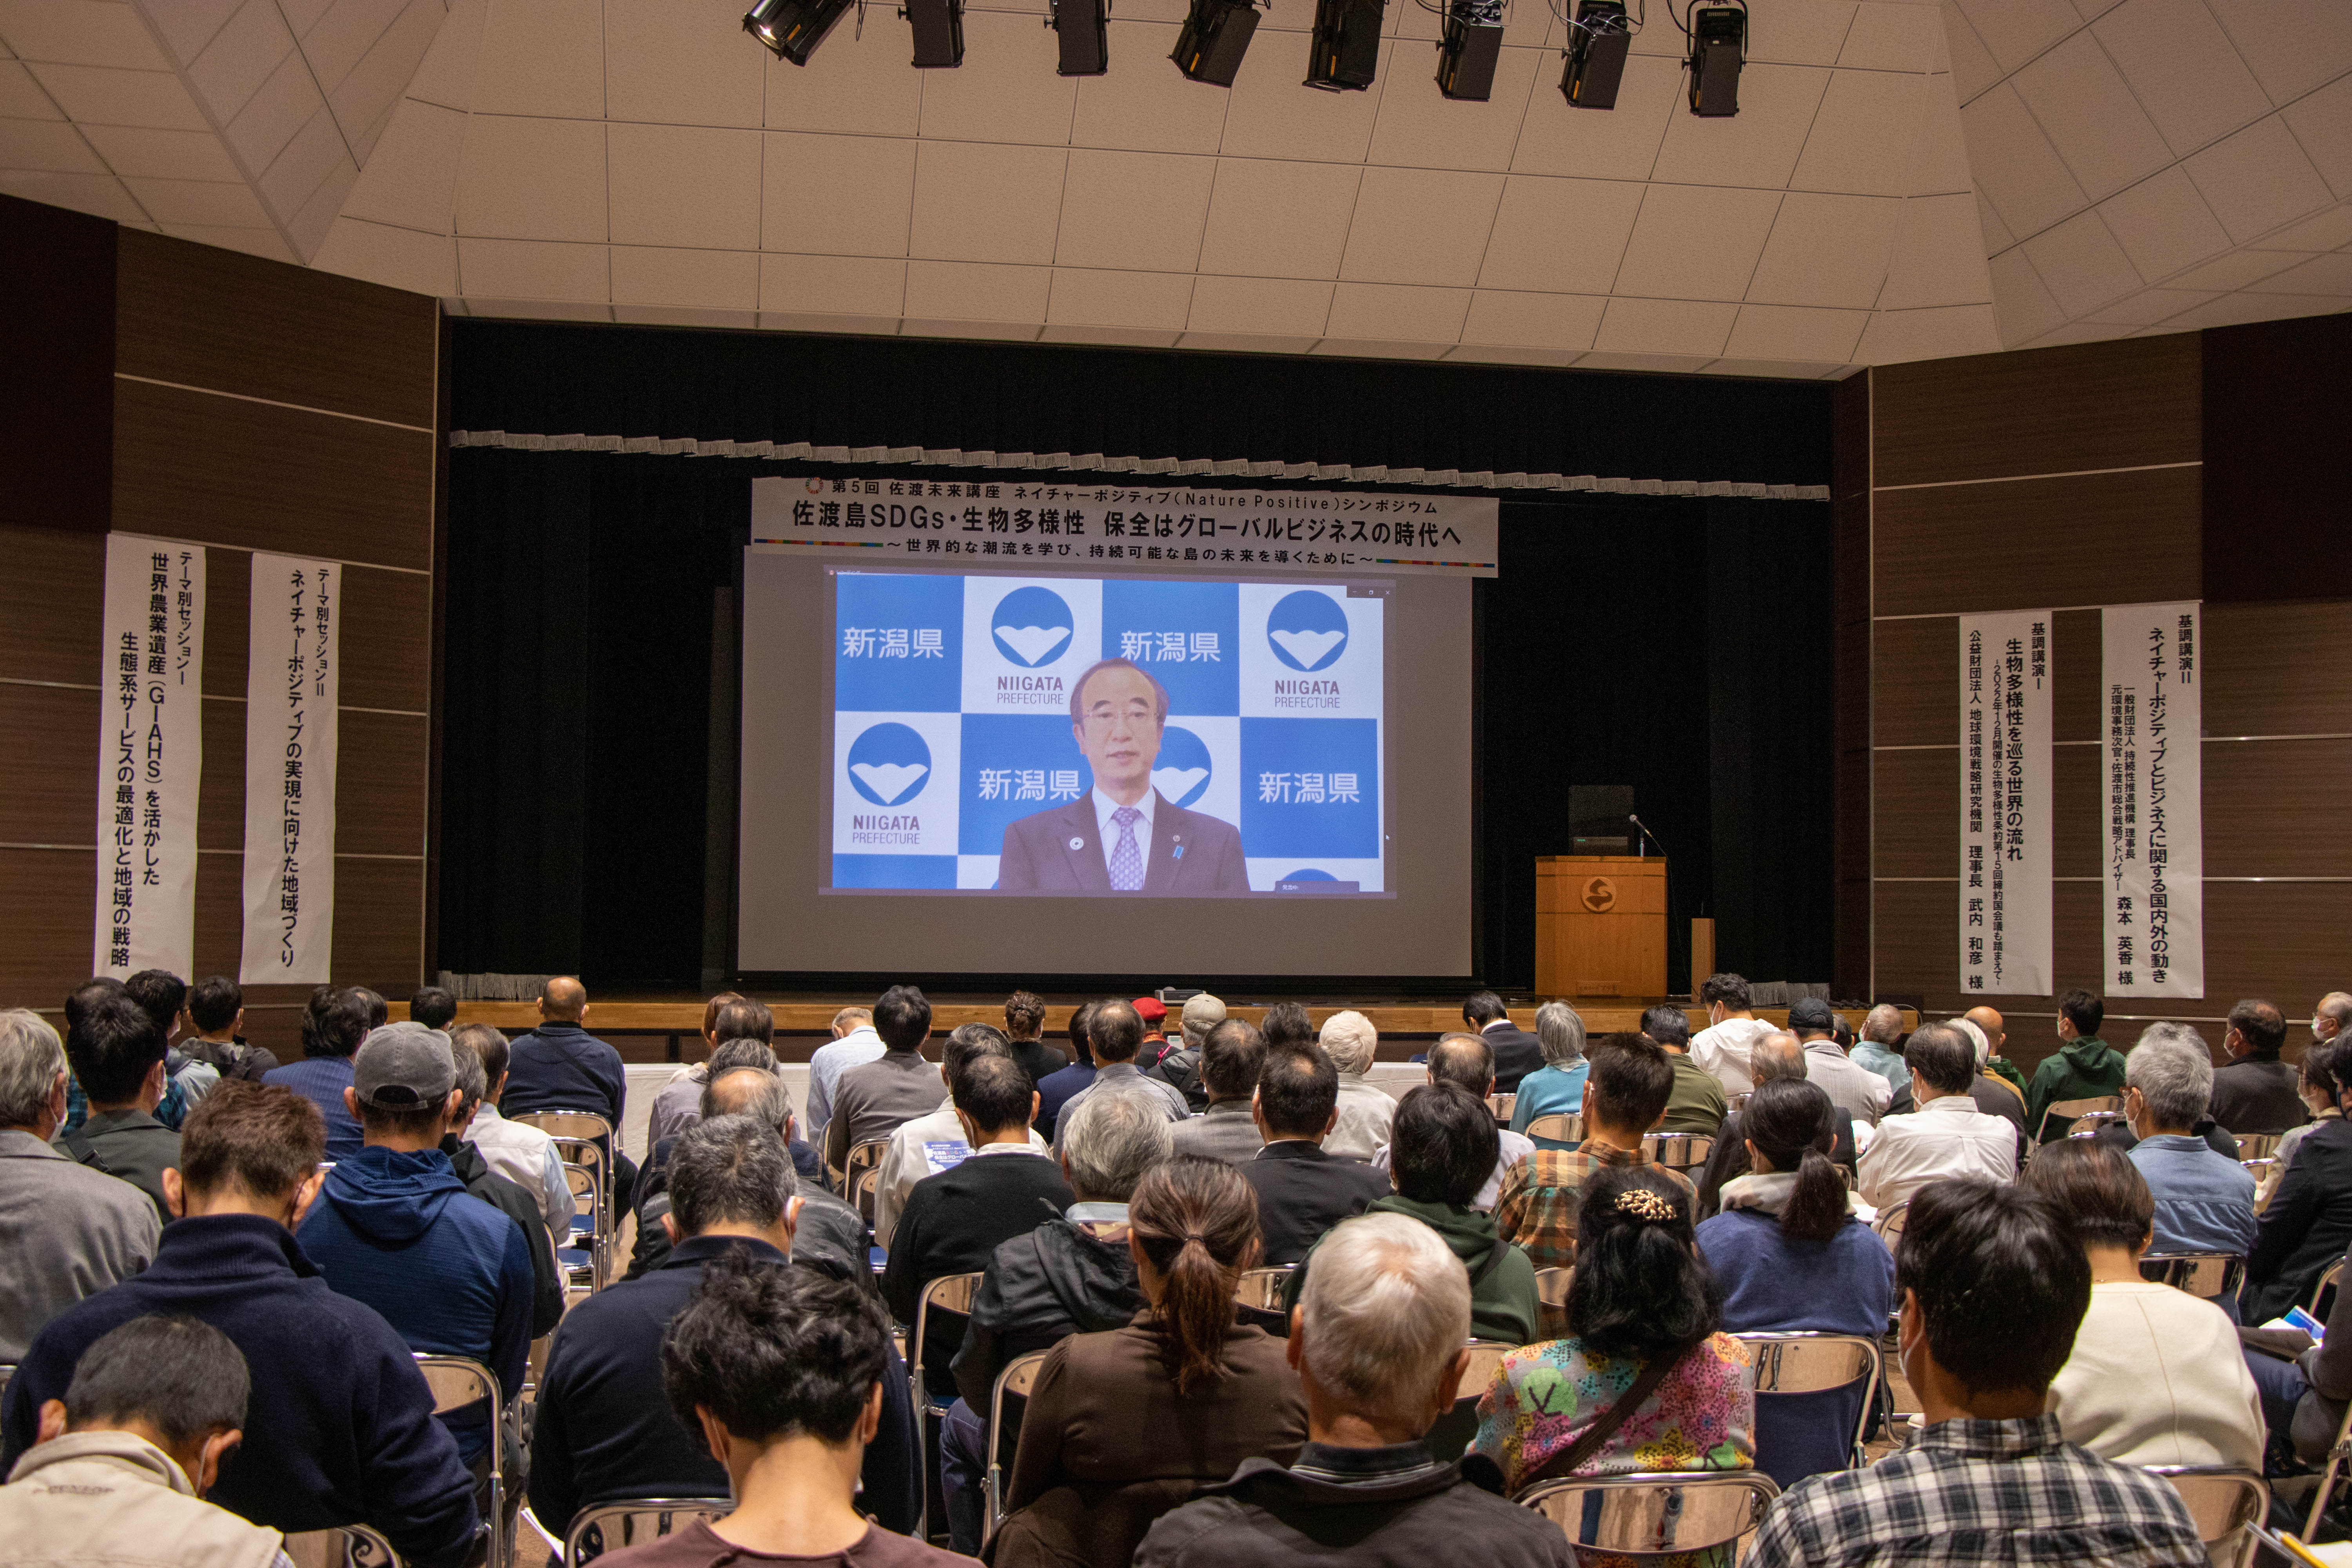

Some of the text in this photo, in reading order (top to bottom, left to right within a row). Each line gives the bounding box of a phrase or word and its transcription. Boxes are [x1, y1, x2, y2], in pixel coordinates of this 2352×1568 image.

[832, 479, 879, 495] 第5回
[889, 481, 1000, 499] 佐渡未来講座
[793, 500, 1461, 547] 佐渡島SDGs・生物多様性 保全はグローバルビジネスの時代へ
[843, 626, 944, 659] 新潟県
[1121, 631, 1220, 662] 新潟県
[997, 693, 1063, 704] PREFECTURE
[998, 676, 1063, 691] NIIGATA
[1275, 681, 1340, 695] NIIGATA
[1274, 697, 1340, 708] PREFECTURE
[2124, 688, 2136, 746] 一般財団法人
[2005, 638, 2024, 861] 生物多様性を巡る世界の流れ
[281, 570, 306, 967] ネイチャーポジティブの実現に向けた地域づくり
[979, 768, 1081, 801] 新潟県
[111, 632, 139, 967] 生態系サービスの最適化と地域の戦略
[1259, 772, 1359, 804] 新潟県
[1969, 630, 1983, 989] 公益財団法人 地球環境戦略研究機関 理事長 武内 和彦 様
[2149, 628, 2169, 983] ネイチャーポジティブとビジネスに関する国内外の動き
[852, 833, 920, 844] PREFECTURE
[853, 815, 920, 831] NIIGATA
[2125, 828, 2136, 859] 理事長
[2117, 897, 2133, 985] 森本 英香 様
